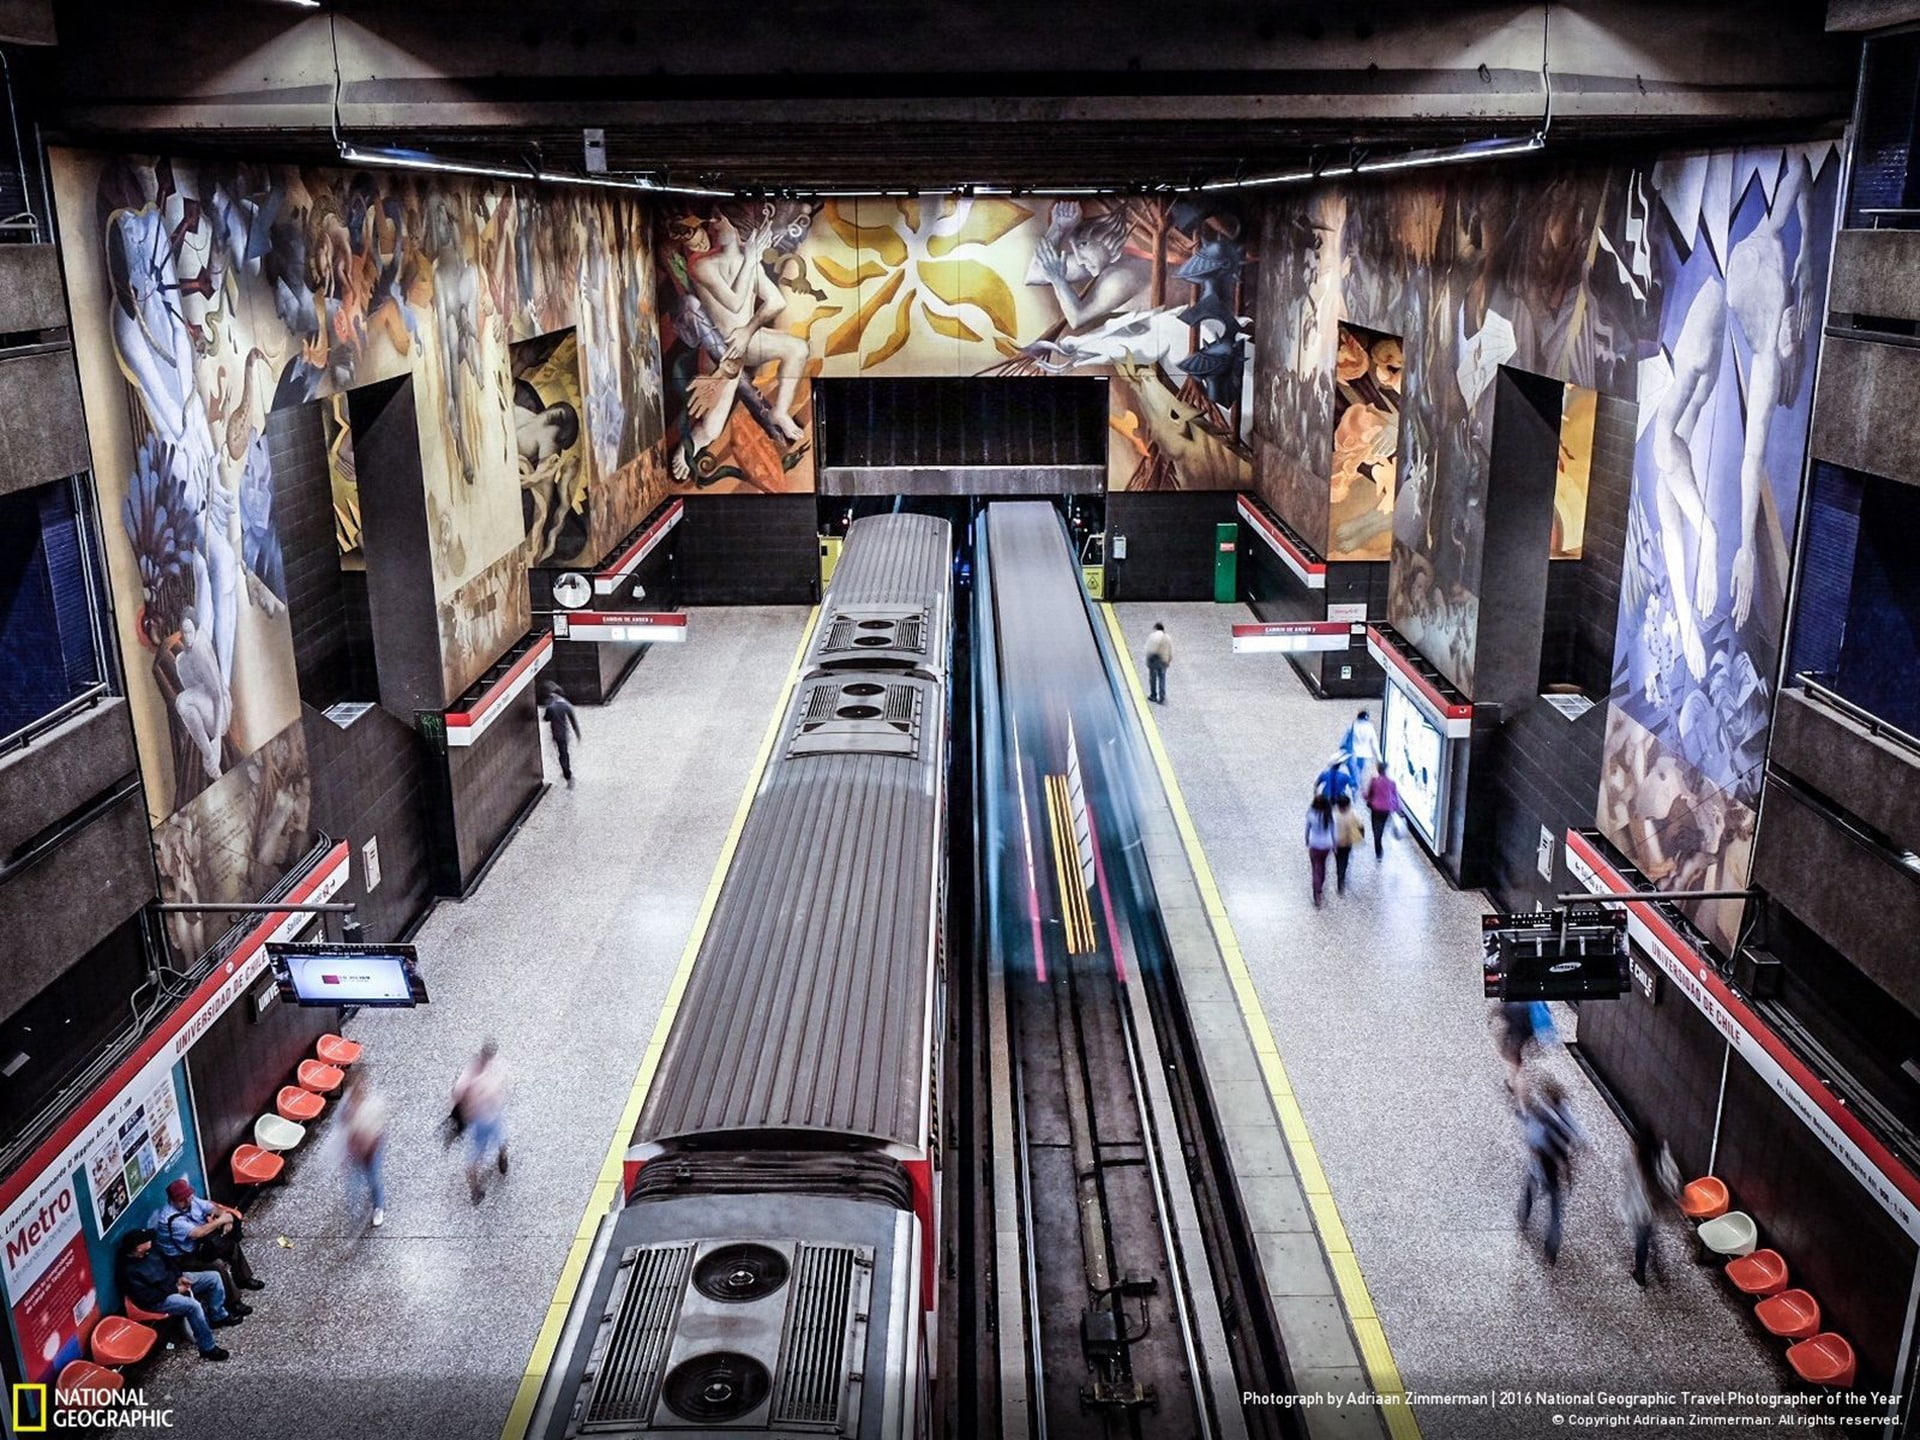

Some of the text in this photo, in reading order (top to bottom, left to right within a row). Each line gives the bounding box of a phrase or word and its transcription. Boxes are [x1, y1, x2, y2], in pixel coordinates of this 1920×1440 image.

[175, 950, 266, 1055] UNIVERSIDAD DE CHILE
[1651, 940, 1741, 1046] UNIVERSIDAD DE CHILE
[5, 1196, 39, 1235] Libertador
[40, 1166, 67, 1198] Bernardo
[6, 1188, 72, 1271] Metro
